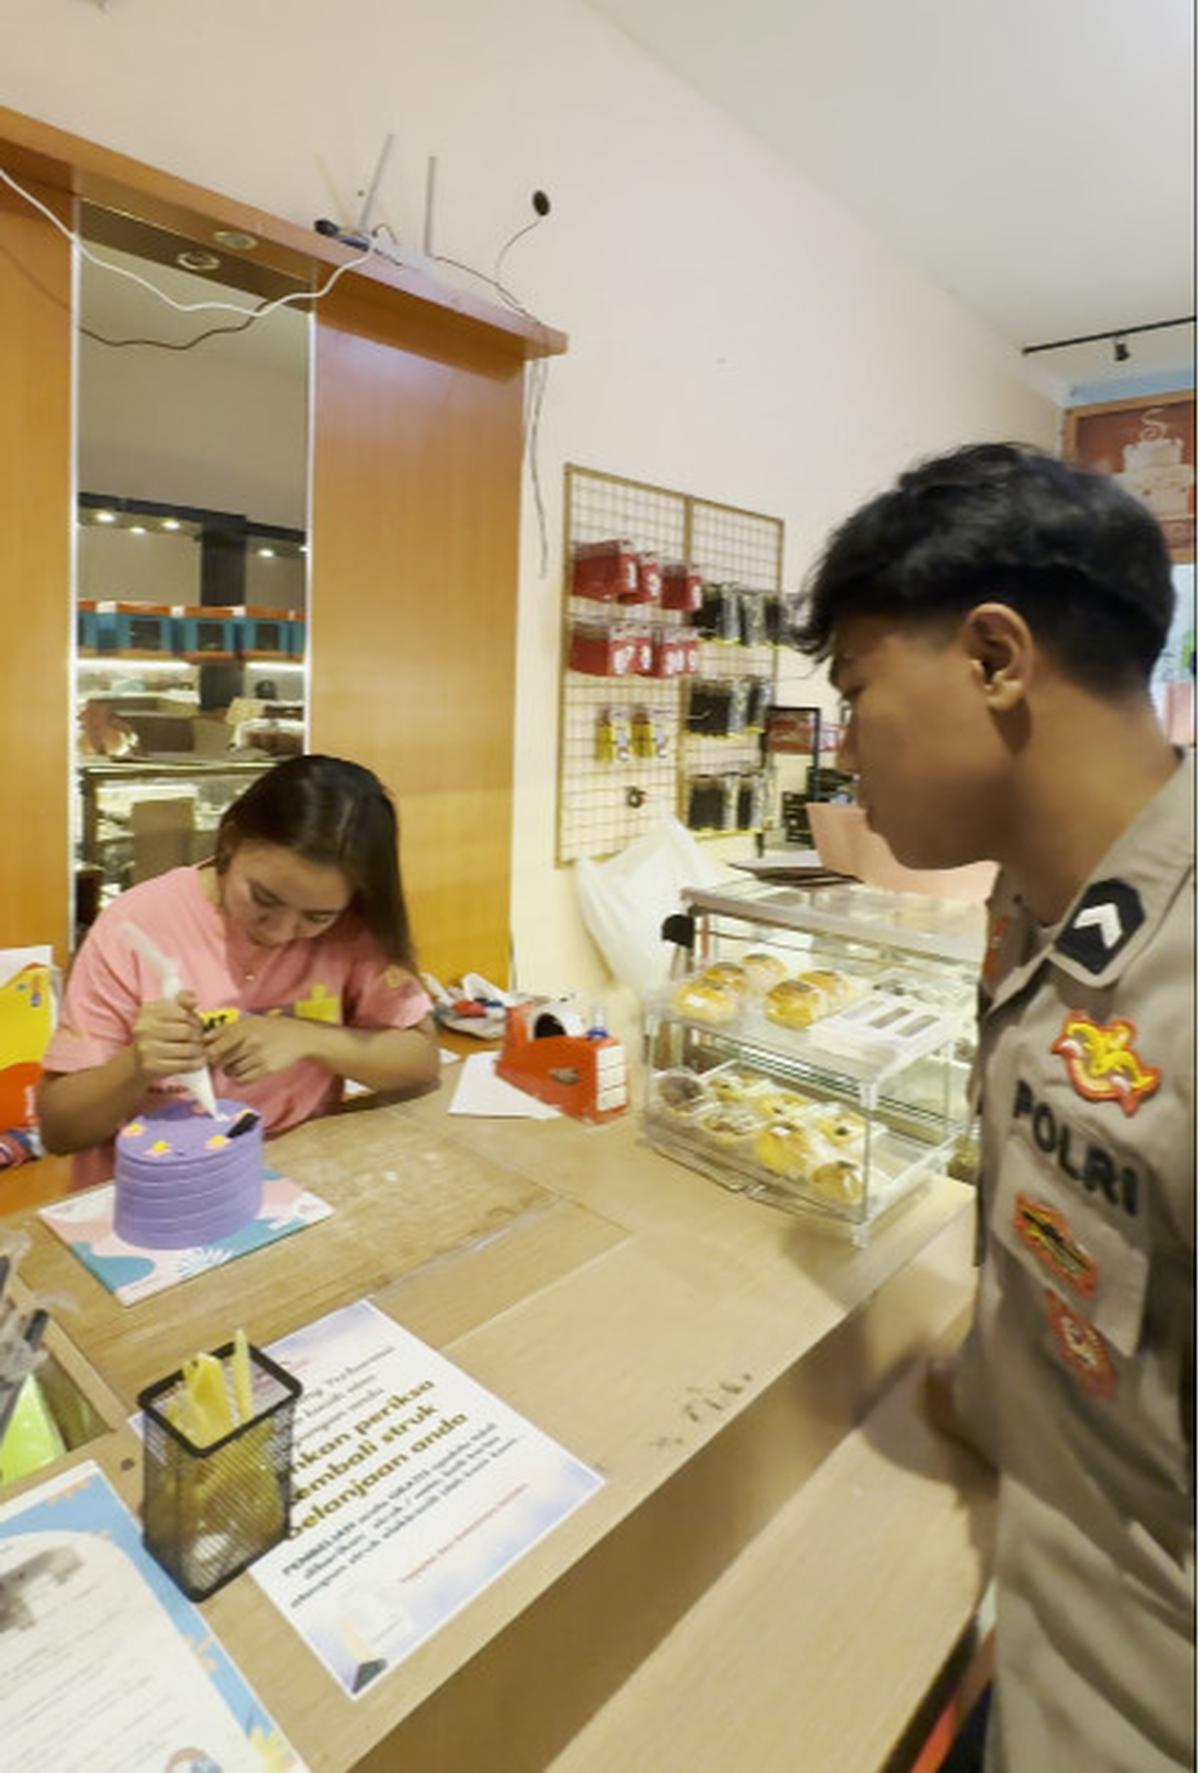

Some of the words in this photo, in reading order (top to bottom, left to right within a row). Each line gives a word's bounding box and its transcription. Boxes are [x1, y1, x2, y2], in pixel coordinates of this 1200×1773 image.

[1012, 1077, 1140, 1218] POLRI
[354, 1379, 436, 1436] periksa
[380, 1405, 438, 1444] struk
[410, 1413, 468, 1453] anda
